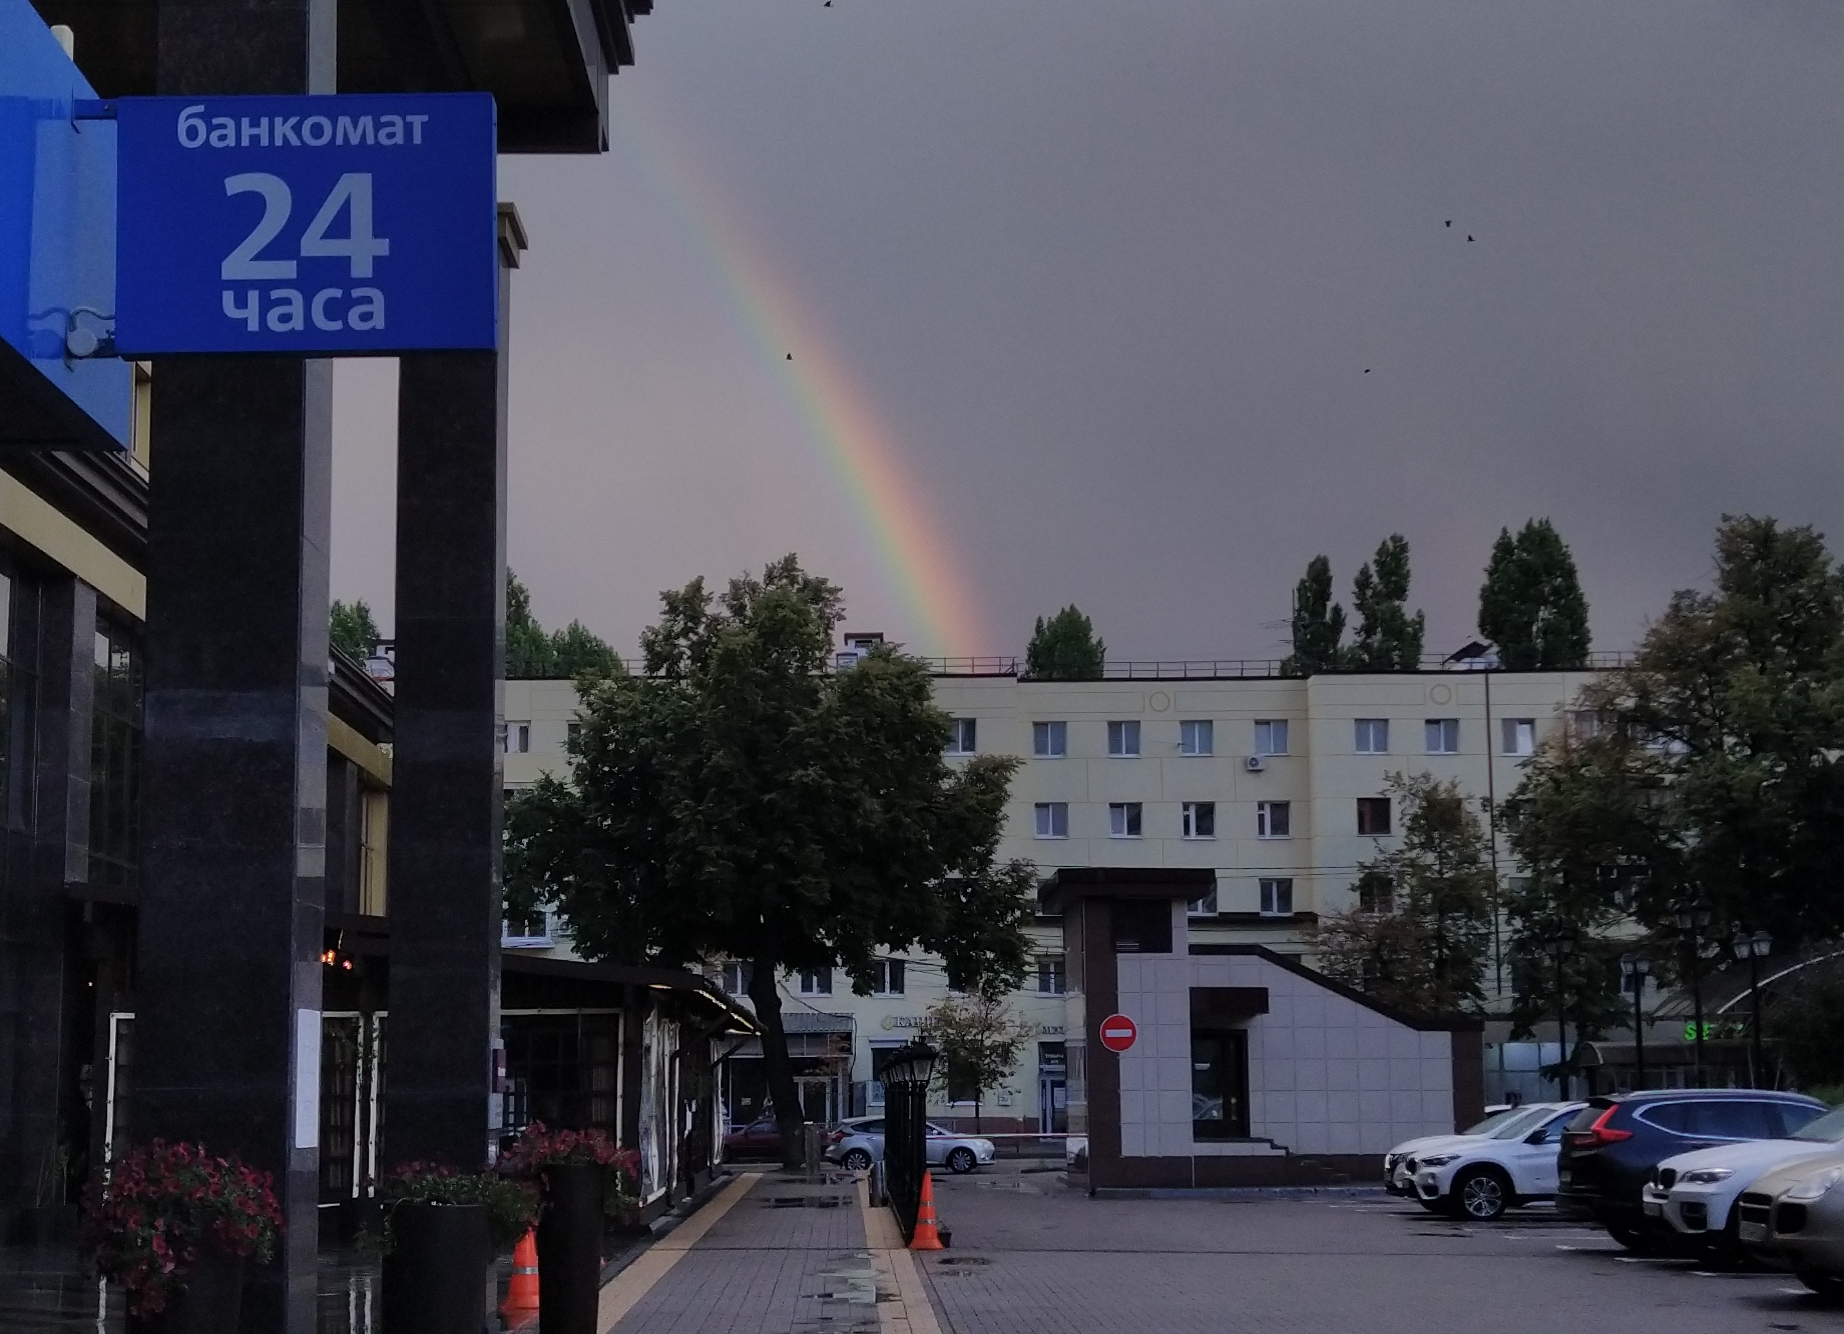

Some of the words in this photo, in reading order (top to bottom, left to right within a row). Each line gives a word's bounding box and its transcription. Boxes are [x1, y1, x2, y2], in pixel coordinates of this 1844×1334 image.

[177, 105, 429, 148] банкомат
[221, 172, 390, 280] 24
[222, 287, 385, 332] часа
